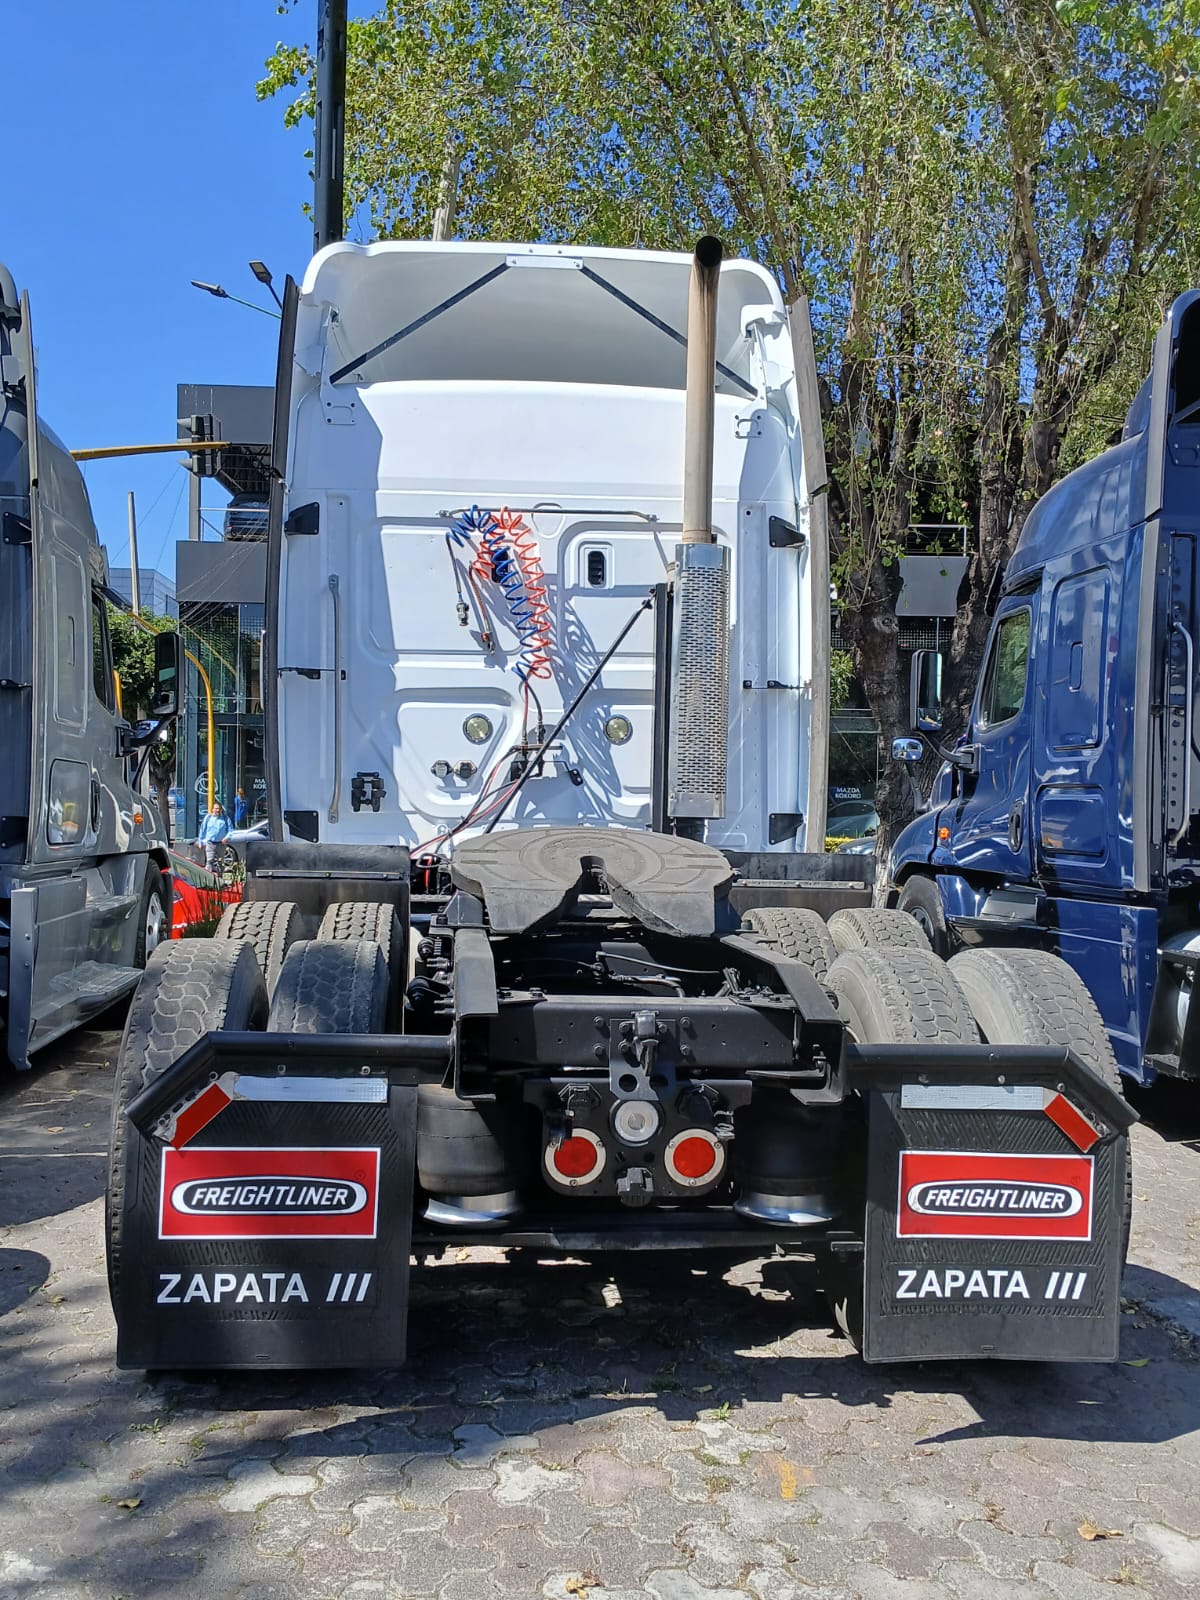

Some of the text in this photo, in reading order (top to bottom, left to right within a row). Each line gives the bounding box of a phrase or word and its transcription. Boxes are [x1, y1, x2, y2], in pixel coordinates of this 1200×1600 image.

[191, 1185, 349, 1206] FREIGHTLINER
[924, 1188, 1066, 1209] FREIGHTLINER
[156, 1273, 309, 1304] ZAPATA
[895, 1269, 1030, 1299] ZAPATA
